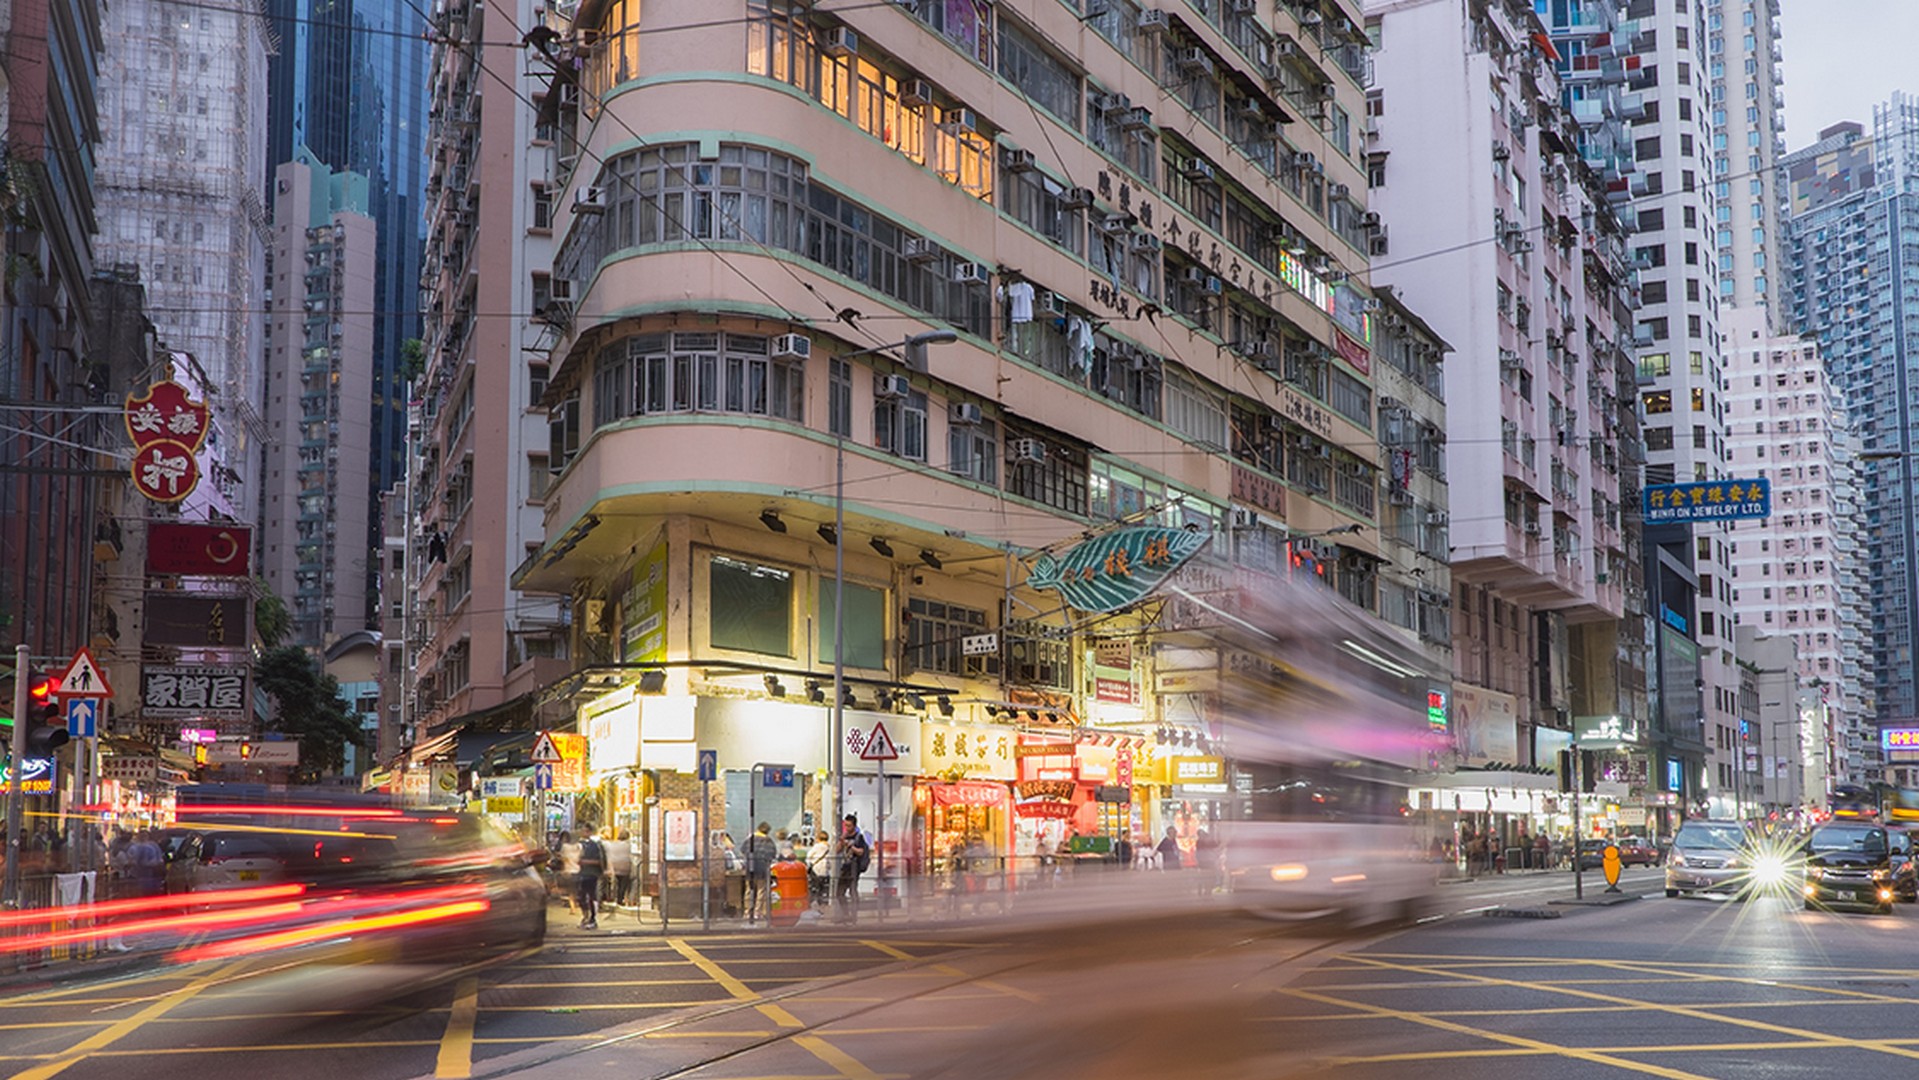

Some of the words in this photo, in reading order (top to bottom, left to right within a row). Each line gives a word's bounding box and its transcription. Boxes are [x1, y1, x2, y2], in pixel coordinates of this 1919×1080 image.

[141, 448, 189, 496] 押
[1677, 507, 1691, 517] ON
[1692, 503, 1739, 517] JEWELRY
[1741, 502, 1764, 514] LTD.
[145, 674, 242, 708] 家賀屋
